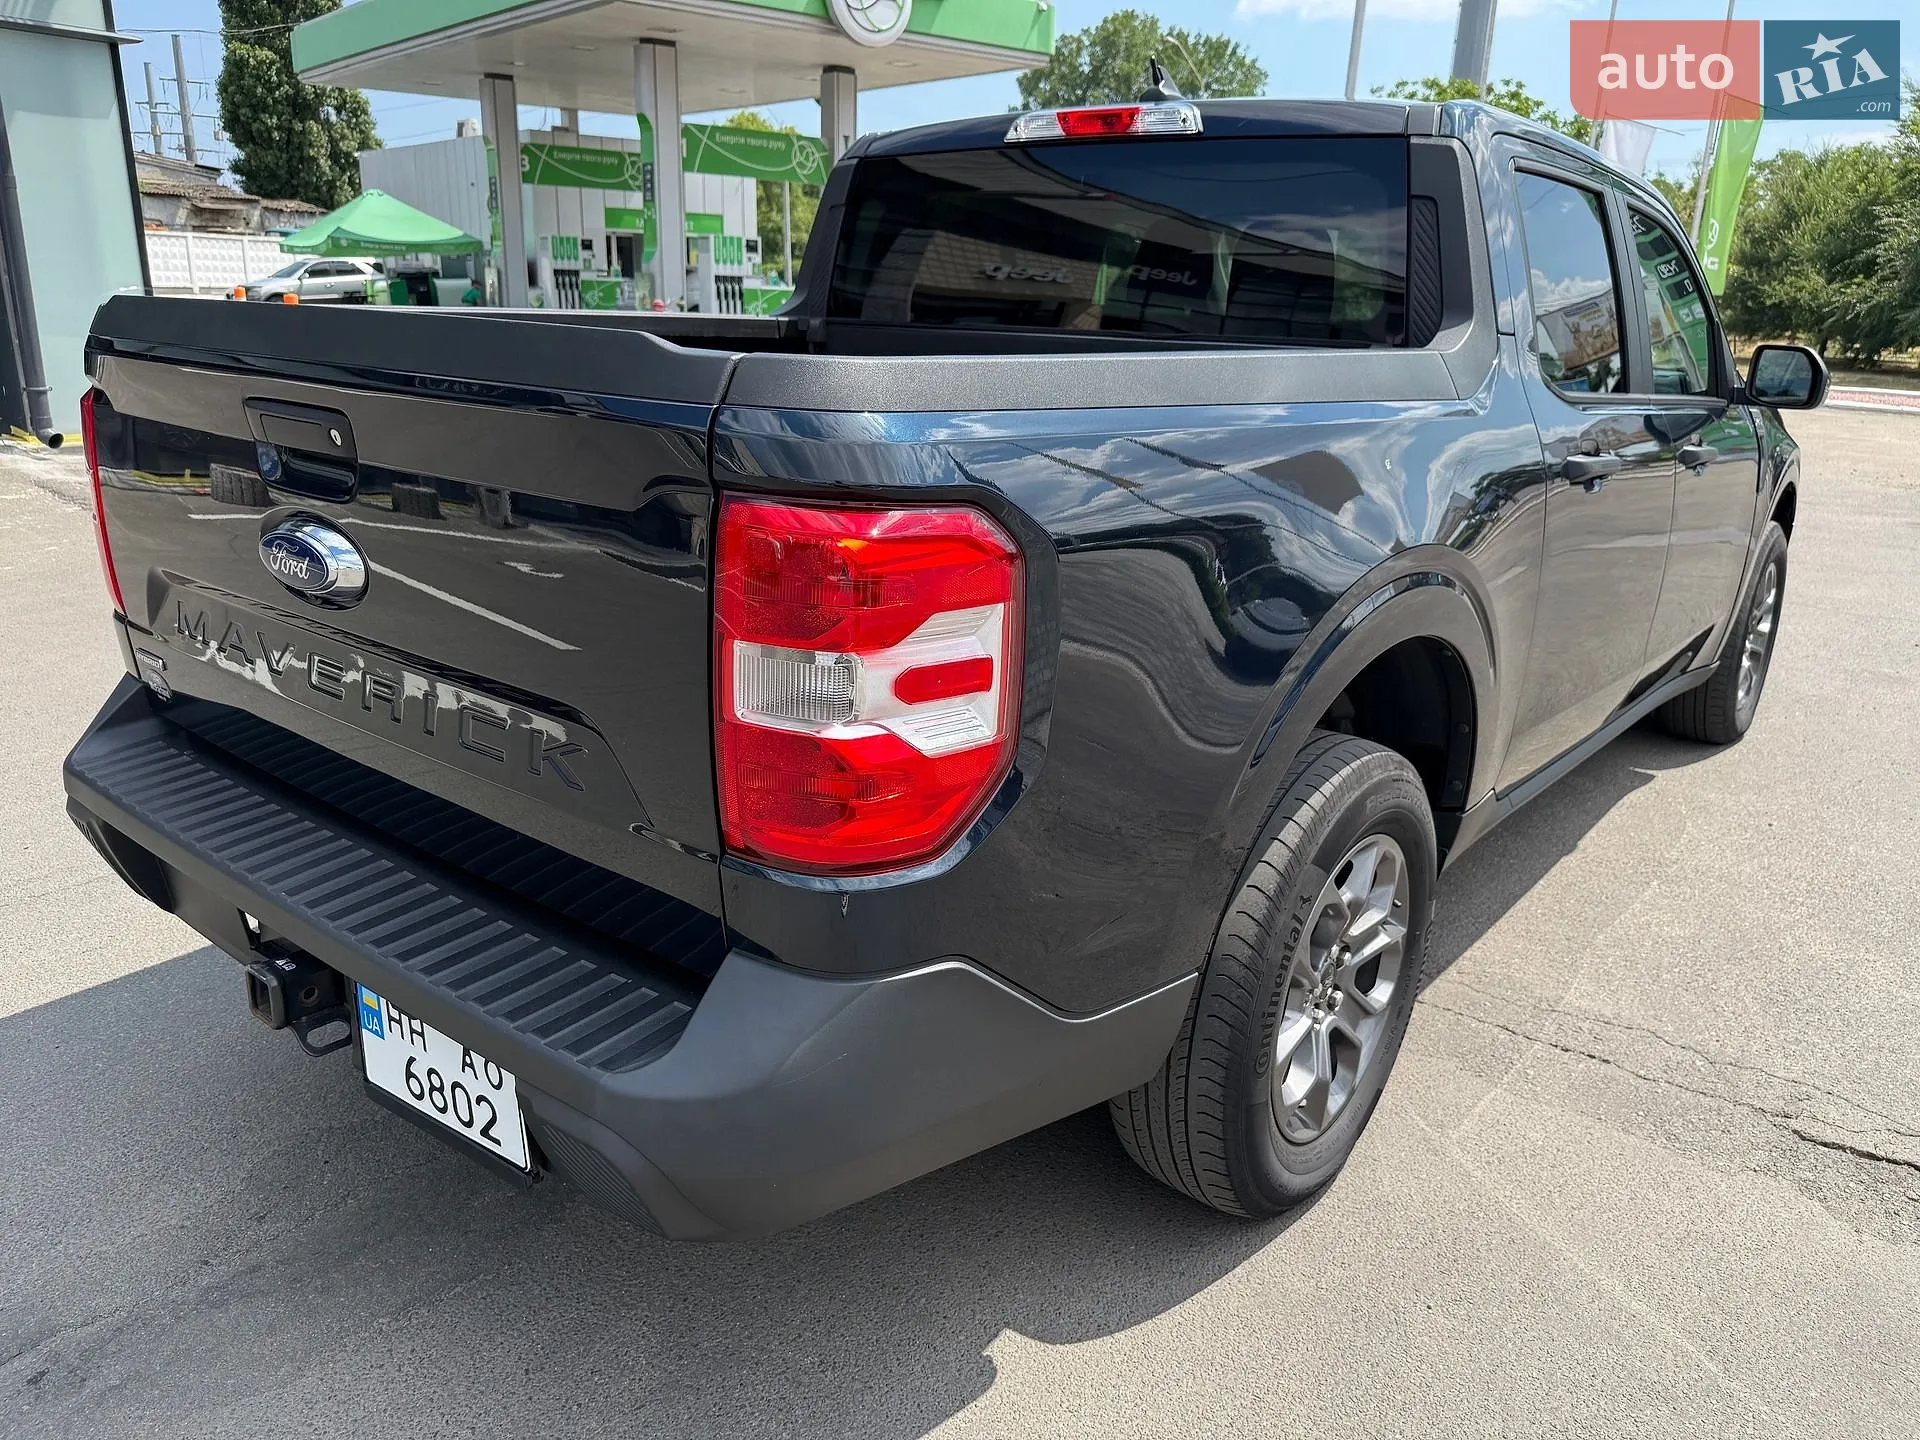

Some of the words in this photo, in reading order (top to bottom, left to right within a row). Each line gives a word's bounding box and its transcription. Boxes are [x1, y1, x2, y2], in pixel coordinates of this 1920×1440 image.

[270, 540, 310, 579] Ford
[176, 599, 586, 791] MAVERICK
[364, 1011, 381, 1035] UA
[386, 1000, 428, 1053] HH
[1255, 913, 1304, 1080] Continental
[405, 1055, 501, 1147] 6802
